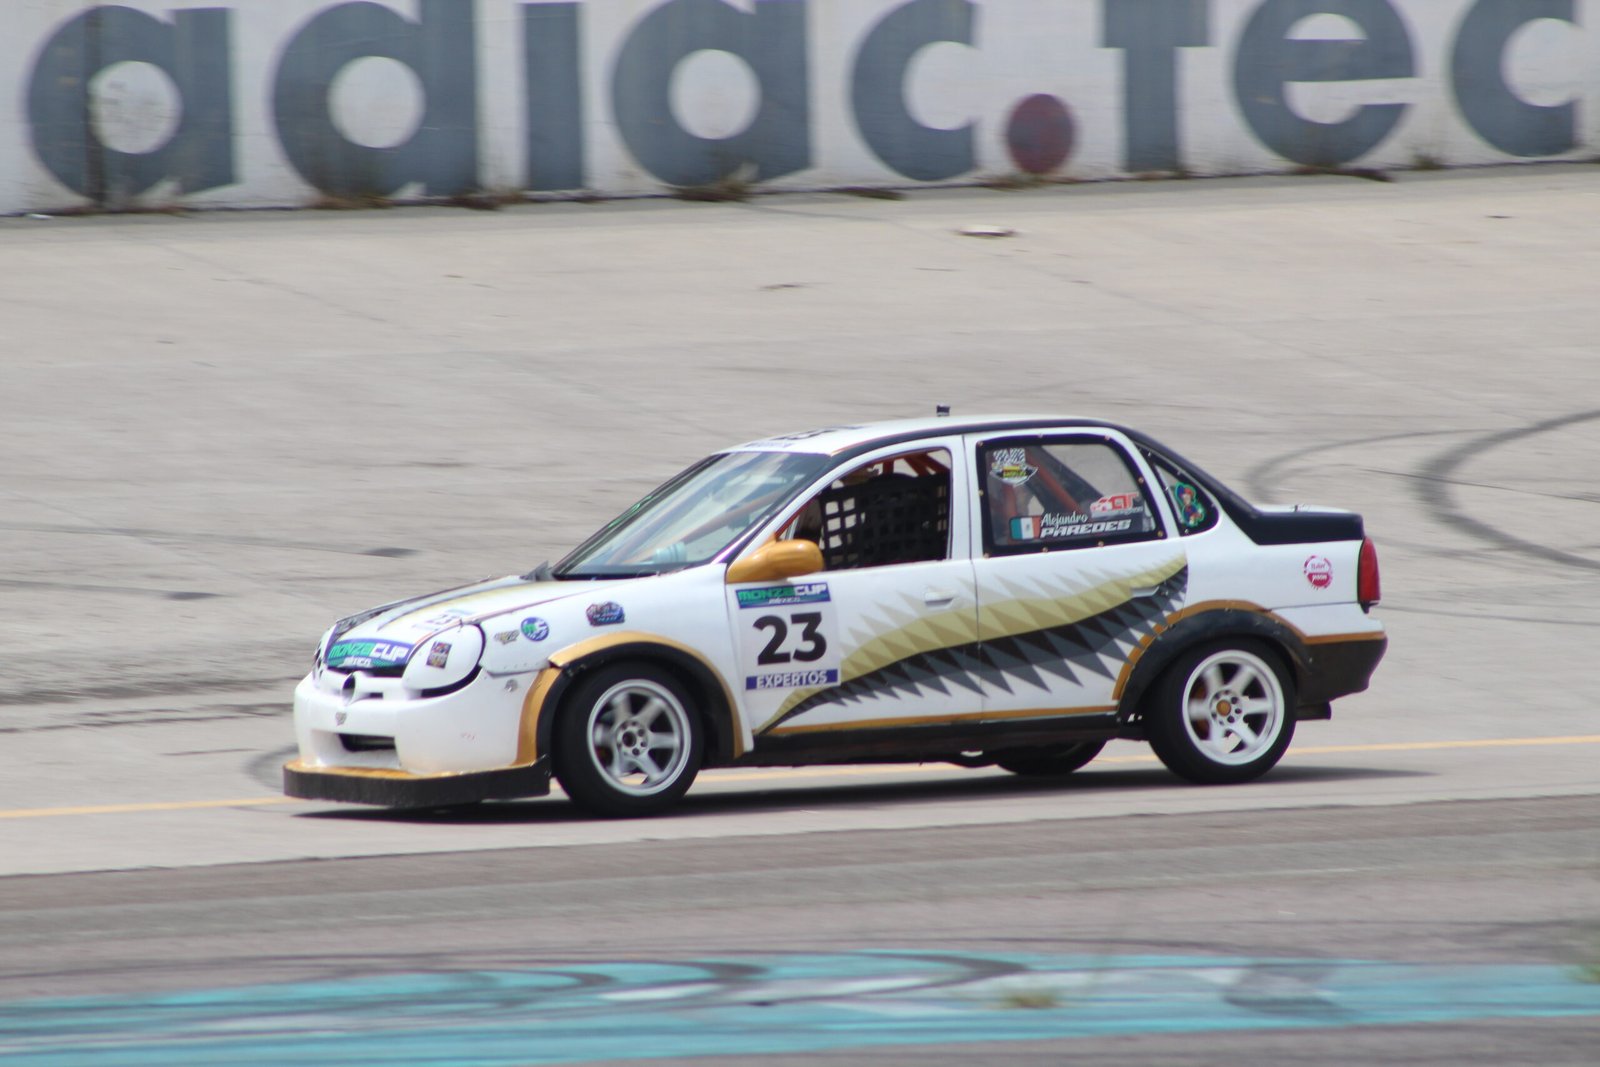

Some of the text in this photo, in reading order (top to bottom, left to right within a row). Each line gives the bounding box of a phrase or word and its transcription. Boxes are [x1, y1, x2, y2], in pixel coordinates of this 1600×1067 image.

[1040, 519, 1132, 538] PAREDES
[1041, 511, 1088, 529] Alejandro
[752, 612, 827, 666] 23
[757, 671, 827, 689] EXPERTOS
